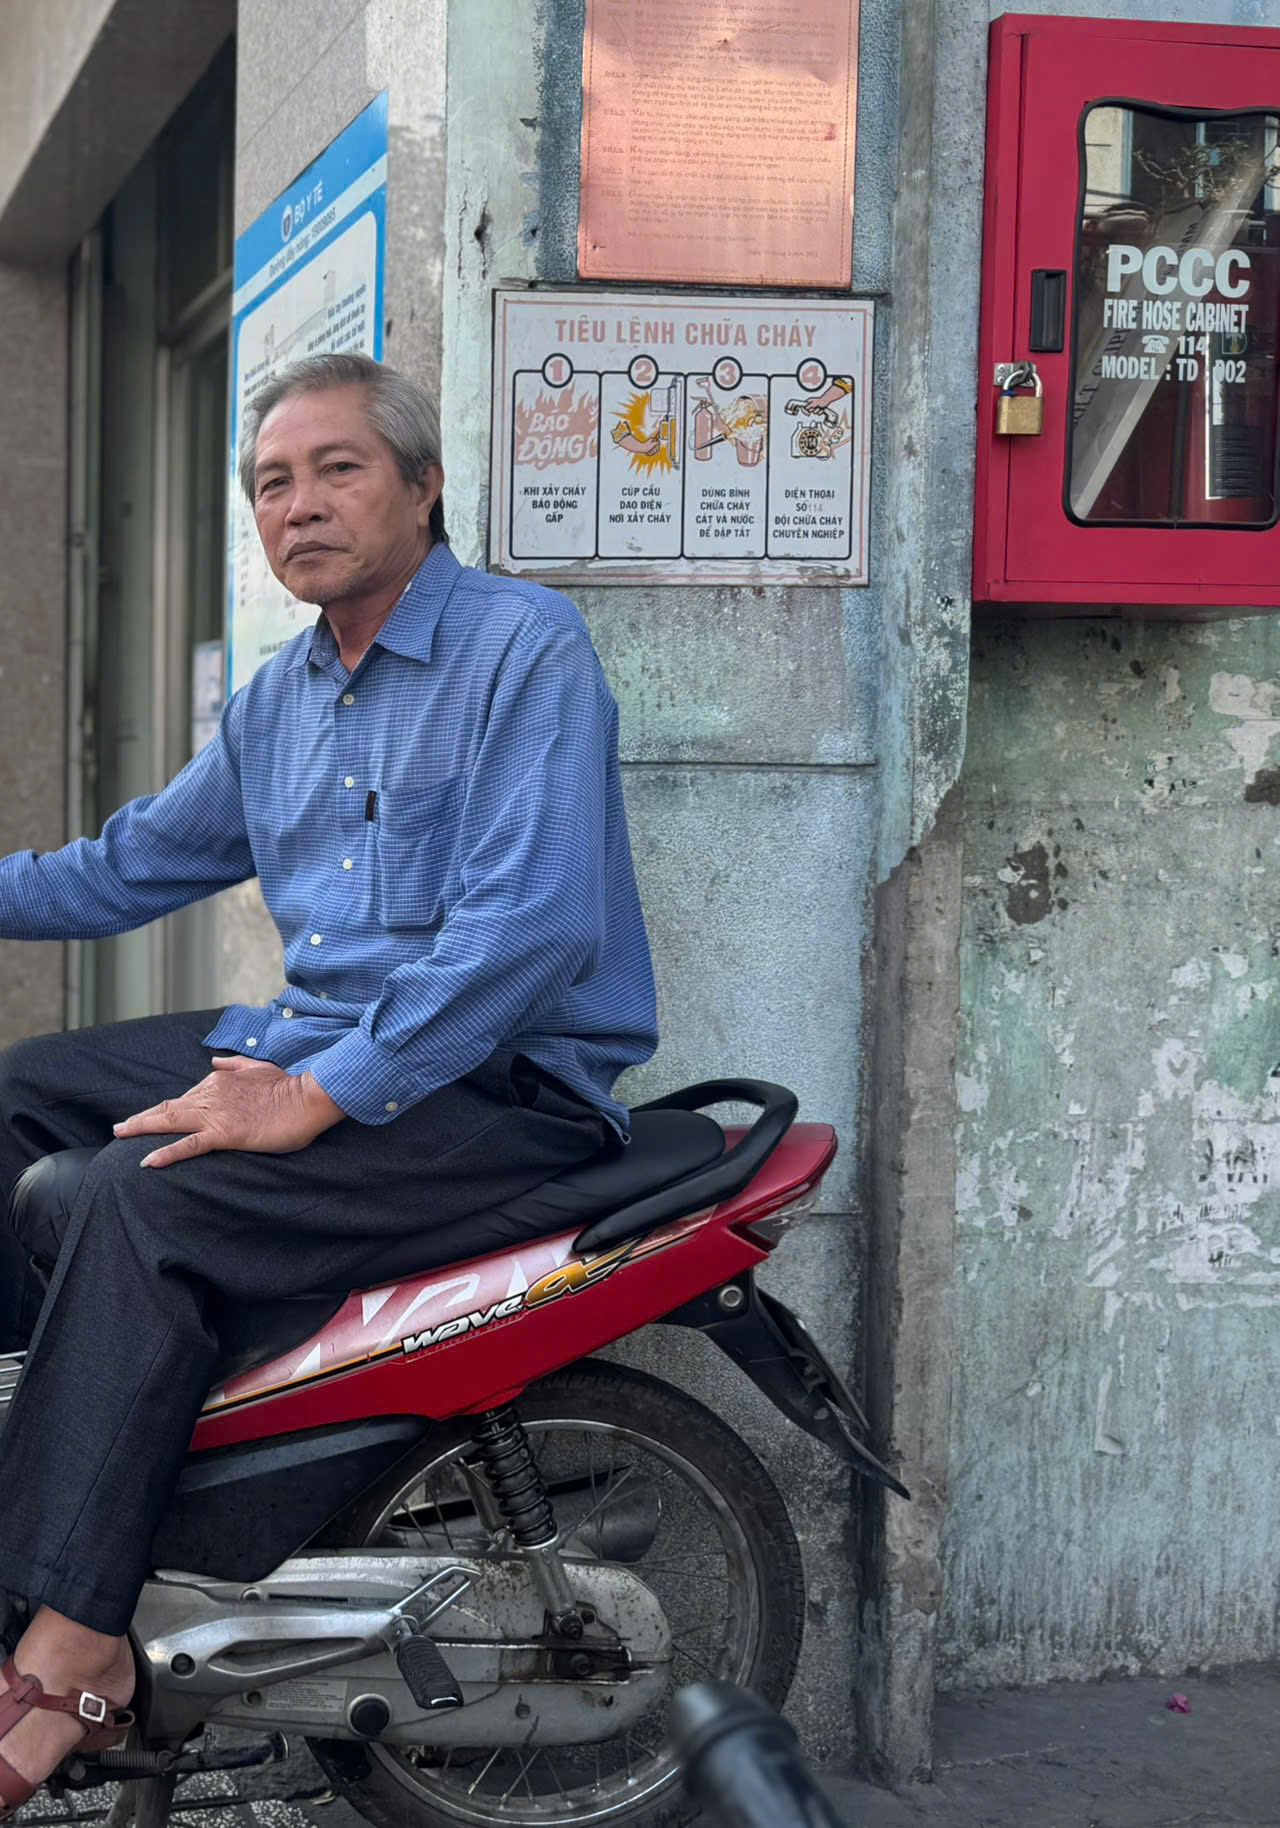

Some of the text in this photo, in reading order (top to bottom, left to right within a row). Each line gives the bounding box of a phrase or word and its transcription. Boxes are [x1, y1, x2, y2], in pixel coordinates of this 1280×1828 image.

[1106, 244, 1251, 298] PCCC
[1103, 298, 1249, 334] FIRE HOSE CABINET
[554, 315, 816, 348] TIÊU LỆNH CHỮA CHÁY
[1177, 335, 1207, 355] 114
[549, 360, 563, 382] 1
[635, 360, 652, 382] 2
[719, 363, 736, 385] 3
[801, 365, 821, 386] 4
[1101, 355, 1161, 380] MODEL
[1176, 358, 1199, 382] TD
[528, 409, 568, 432] BÁO
[519, 434, 584, 466] ĐỘNG
[524, 484, 586, 496] KHI XẢY CHÁY
[621, 484, 639, 496] CÚP
[532, 498, 578, 510] BÁO ĐỘNG
[620, 499, 662, 511] DAO ĐIỆN
[700, 500, 724, 510] CHỮA
[795, 499, 823, 513] SỐ 114
[545, 511, 564, 523] GẤP
[609, 511, 671, 523] NƠI XẢY CHÁY
[695, 513, 713, 524] CÁT
[730, 514, 755, 524] NƯỚC
[774, 513, 843, 526] ĐỘI CHỮA CHÁY
[772, 527, 845, 540] CHUYÊN NGHIỆP
